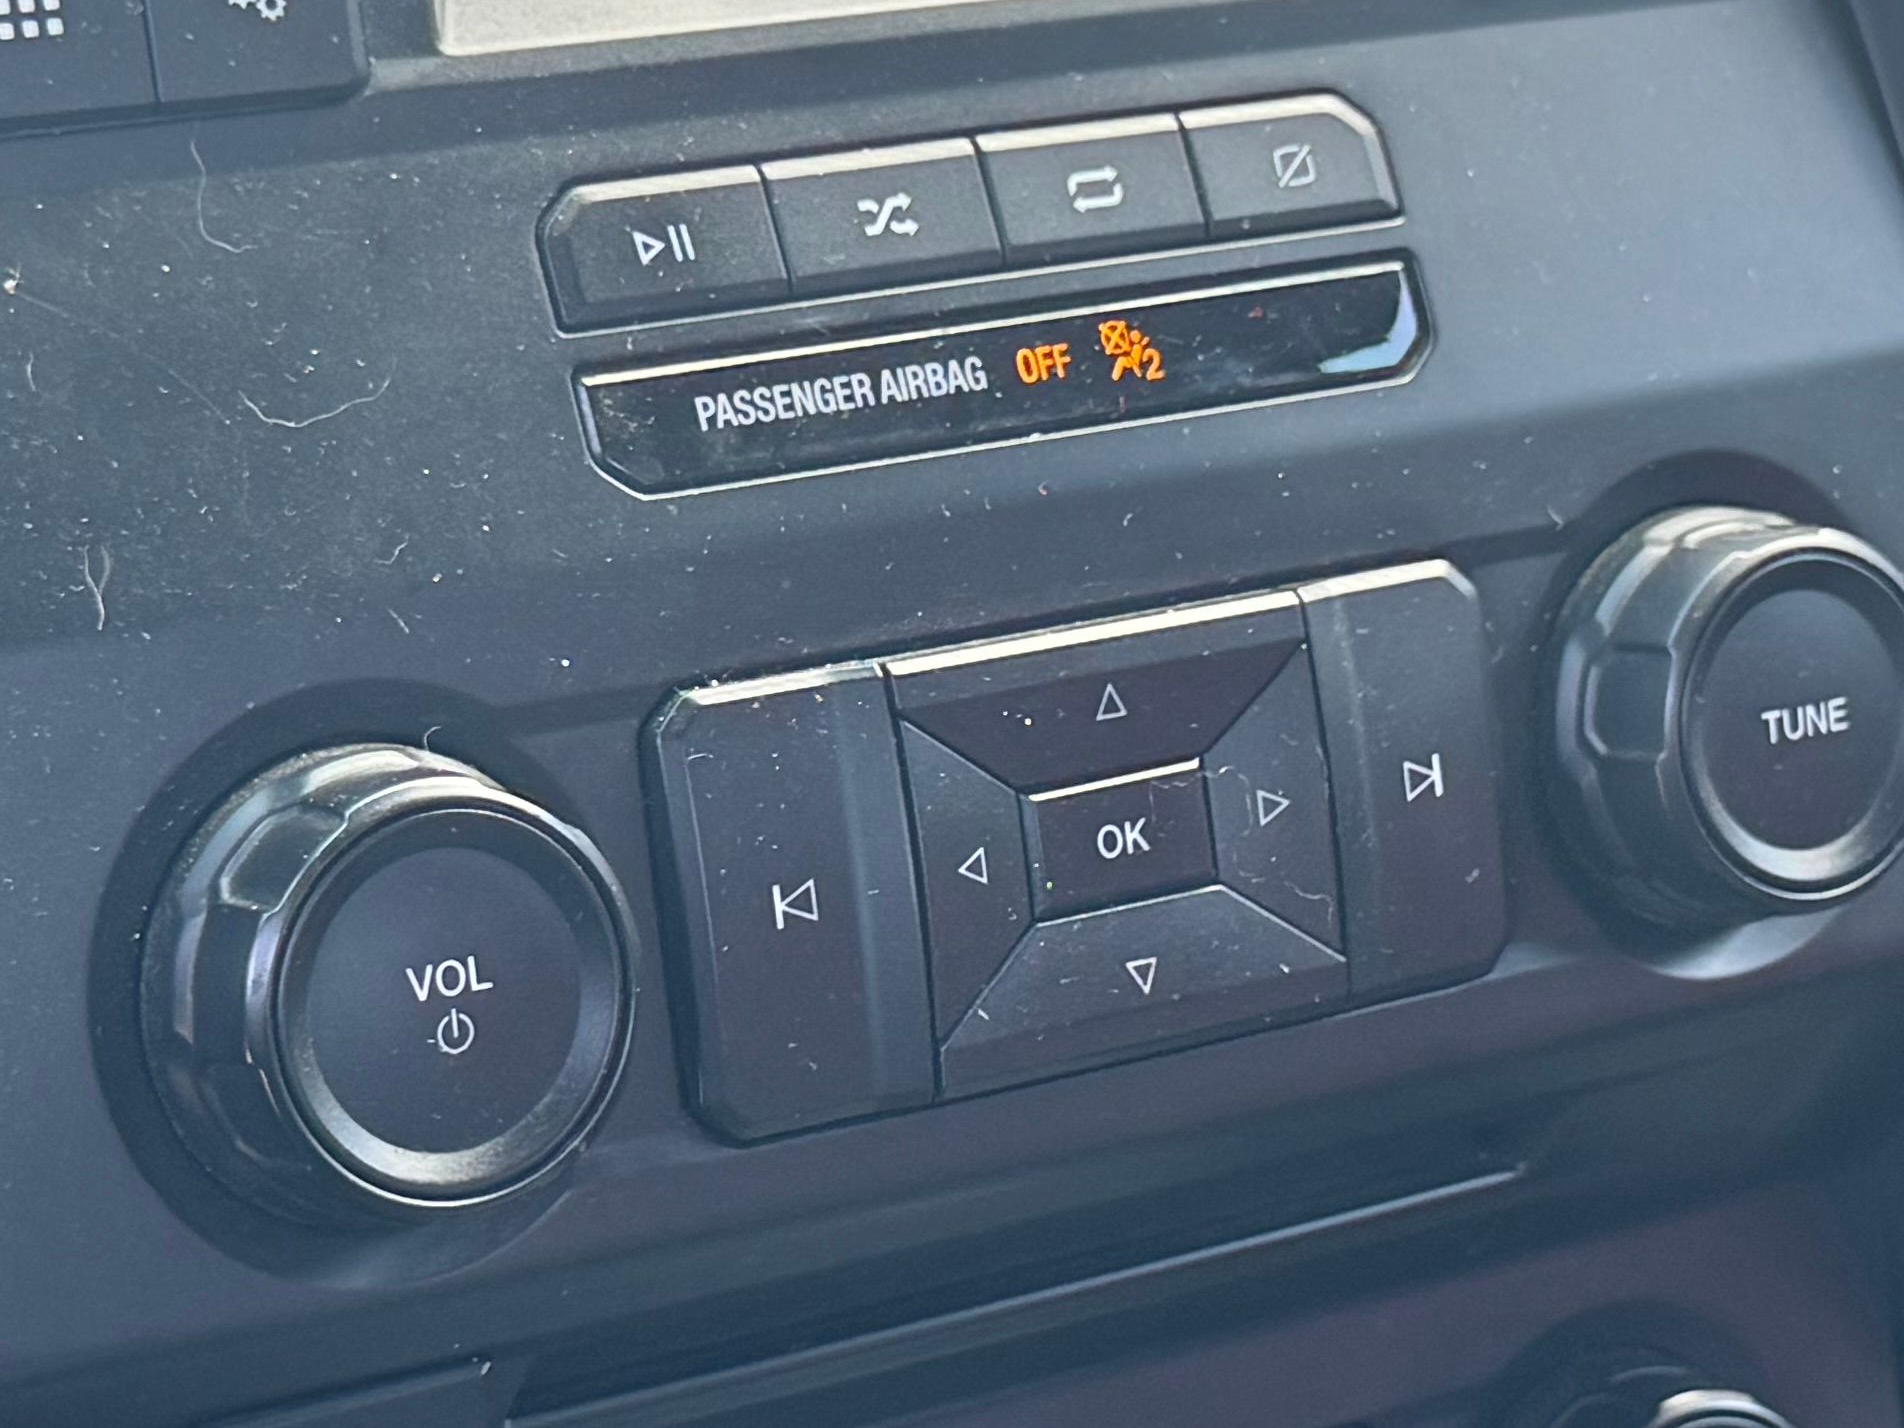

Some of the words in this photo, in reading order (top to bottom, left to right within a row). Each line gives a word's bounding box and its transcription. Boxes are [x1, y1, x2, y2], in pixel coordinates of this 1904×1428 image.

[696, 373, 875, 433] PASSENGER
[879, 355, 989, 408] AIRBAG
[1016, 342, 1072, 385] OFF
[1761, 695, 1850, 745] TUNE
[1097, 817, 1151, 860] OK
[405, 955, 494, 1002] VOL
